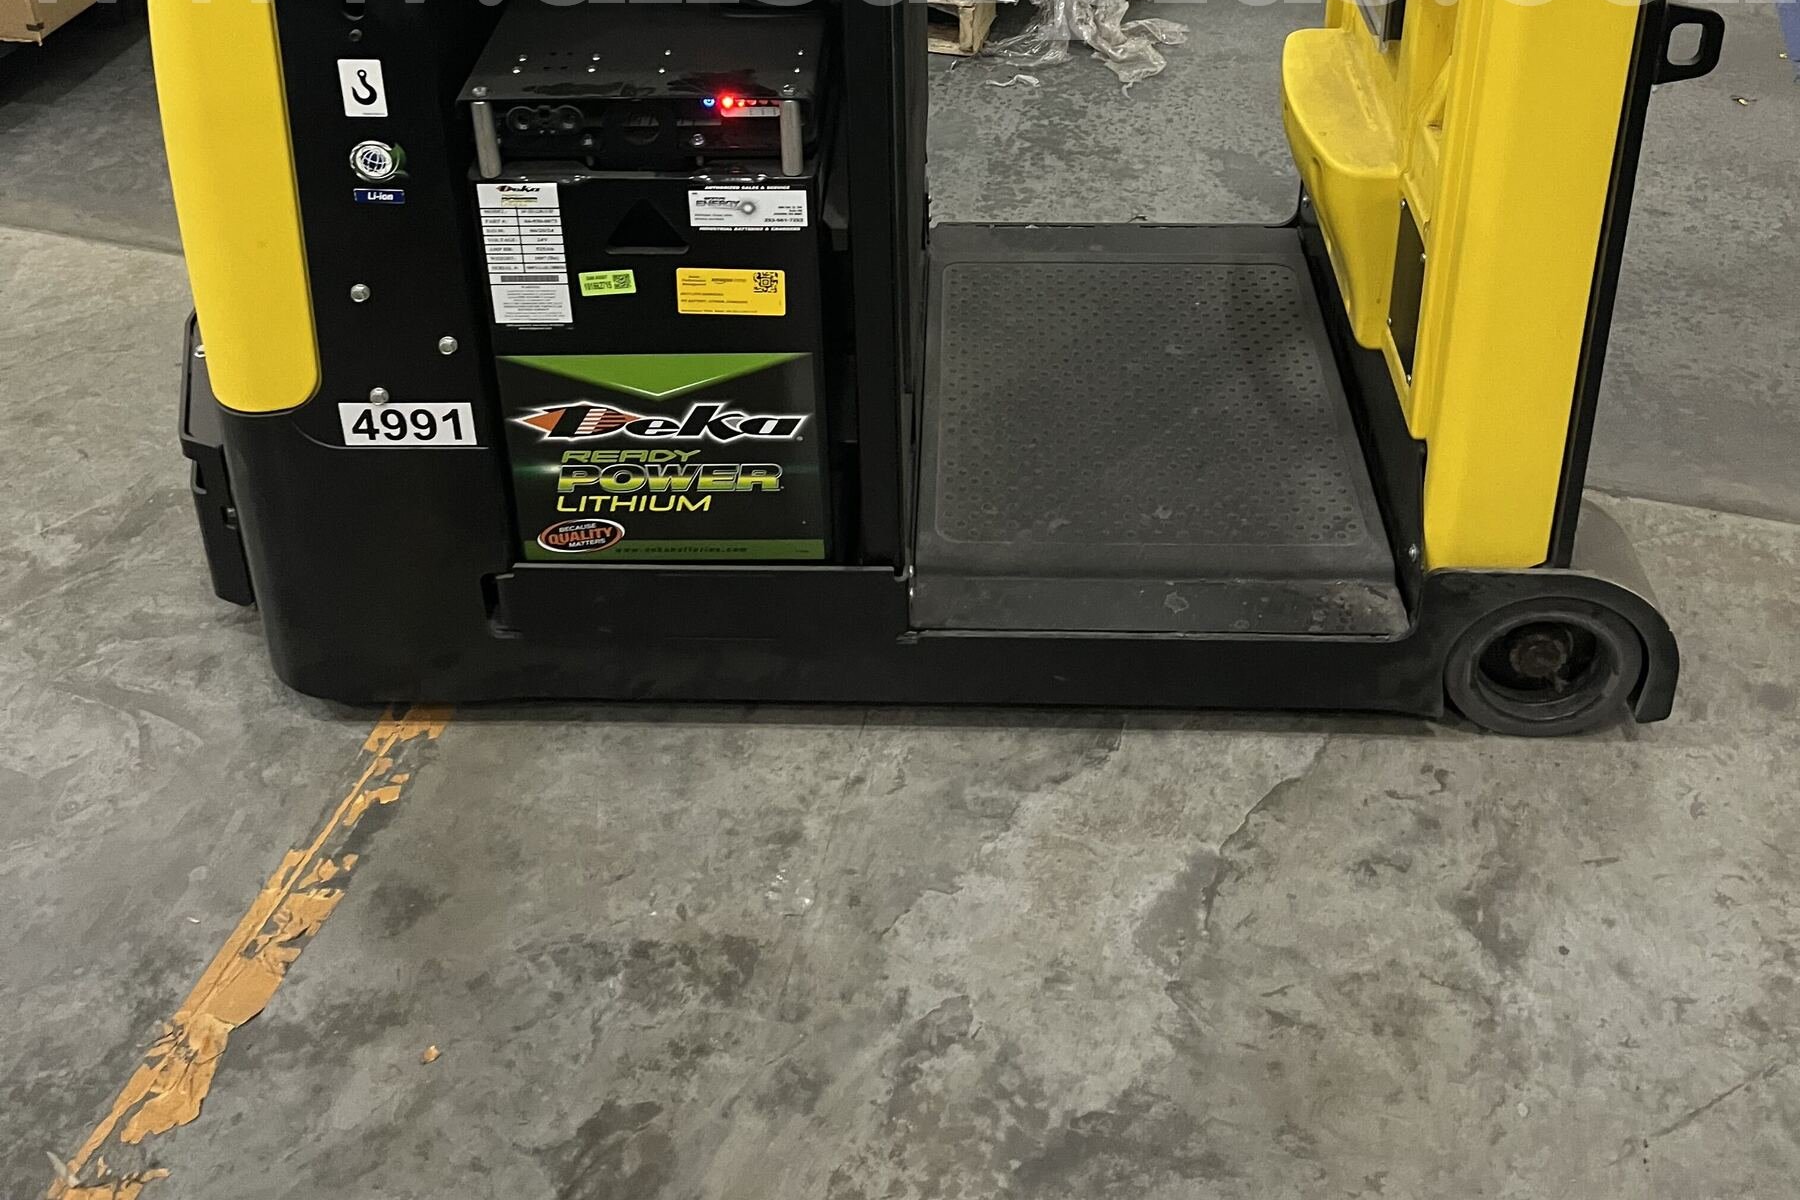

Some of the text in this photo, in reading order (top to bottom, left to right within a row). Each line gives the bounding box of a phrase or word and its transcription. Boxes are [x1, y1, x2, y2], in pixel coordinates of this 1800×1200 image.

[367, 191, 394, 201] Li-ion
[496, 185, 541, 193] Deka
[351, 408, 463, 441] 4991
[514, 401, 808, 442] Deka
[561, 449, 702, 463] READY
[556, 462, 784, 493] POWER
[556, 494, 713, 512] LITHIUM
[558, 521, 598, 533] BECAUSE
[548, 526, 614, 546] QUALITY
[567, 537, 607, 548] MATTERS
